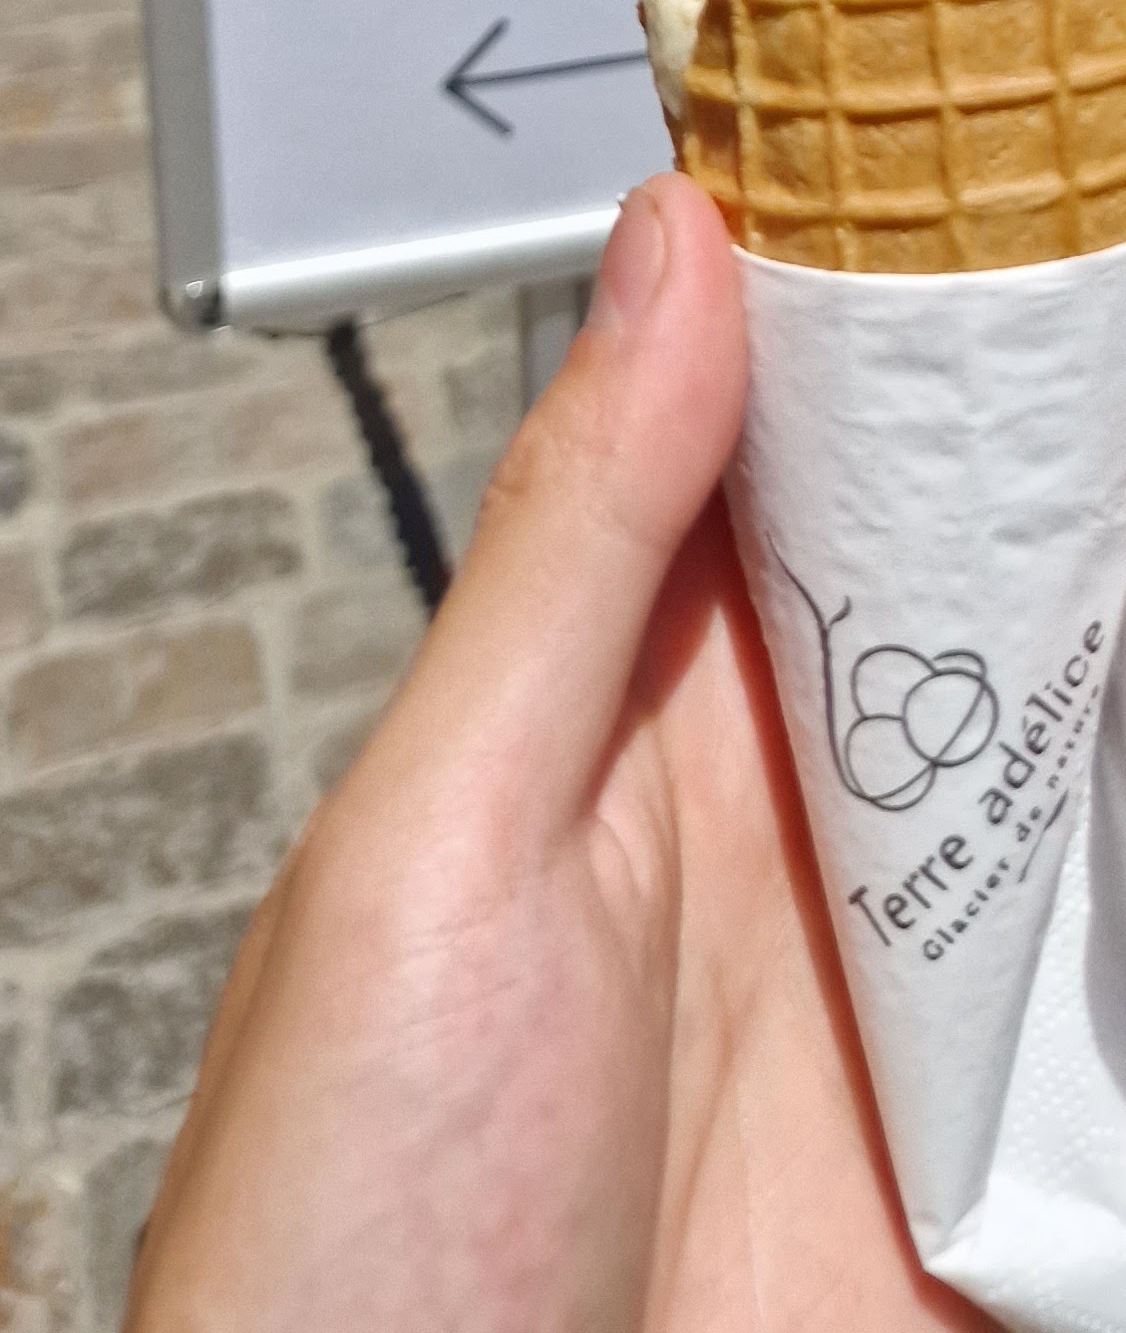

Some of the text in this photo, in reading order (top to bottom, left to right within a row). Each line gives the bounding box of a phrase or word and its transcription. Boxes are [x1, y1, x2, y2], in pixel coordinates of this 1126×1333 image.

[848, 620, 1106, 947] Terre adélice
[922, 858, 1010, 961] Glacier
